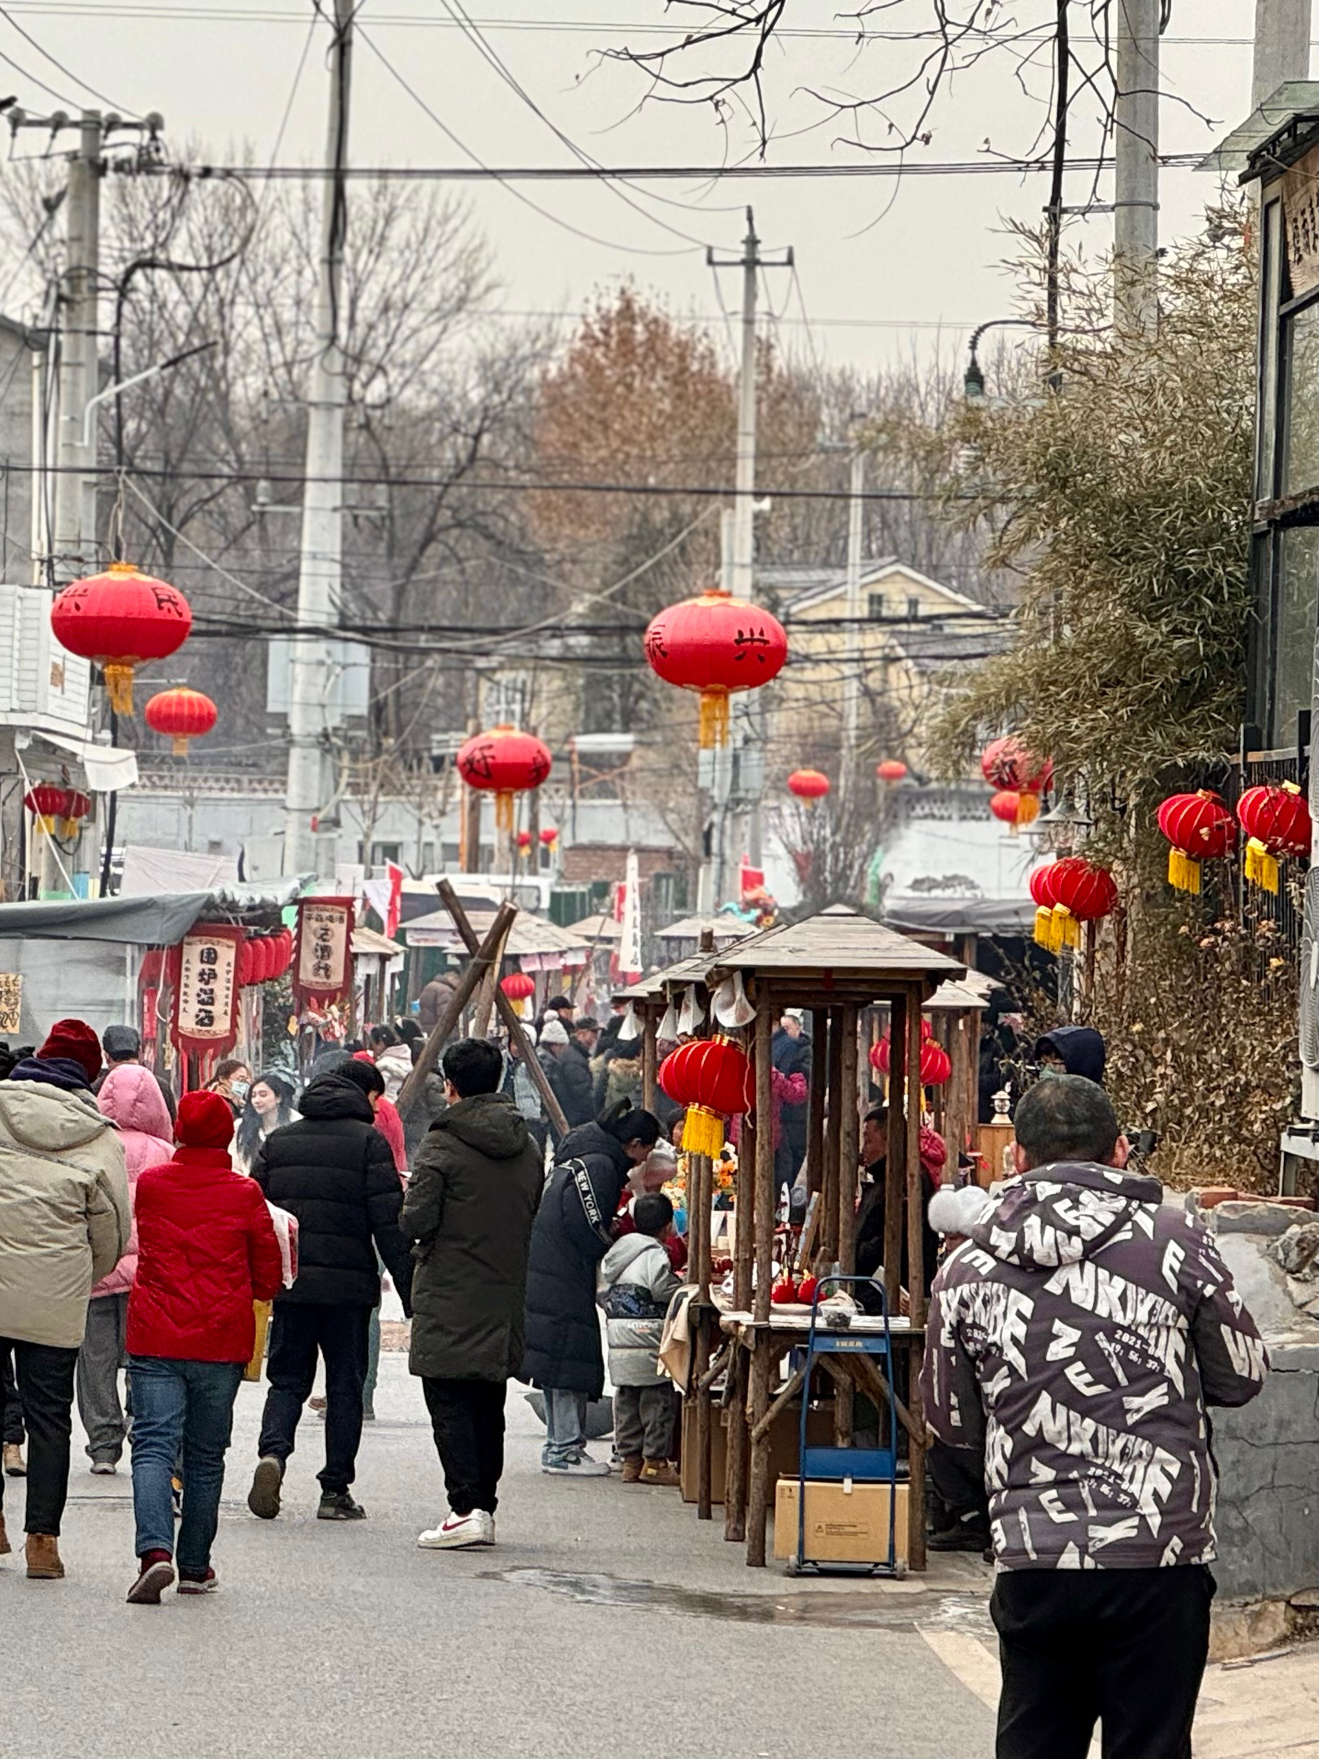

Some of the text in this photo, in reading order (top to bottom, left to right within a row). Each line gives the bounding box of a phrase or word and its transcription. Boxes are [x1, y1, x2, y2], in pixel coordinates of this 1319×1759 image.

[195, 947, 218, 1027] 围炉温酒
[583, 1193, 600, 1224] YORK
